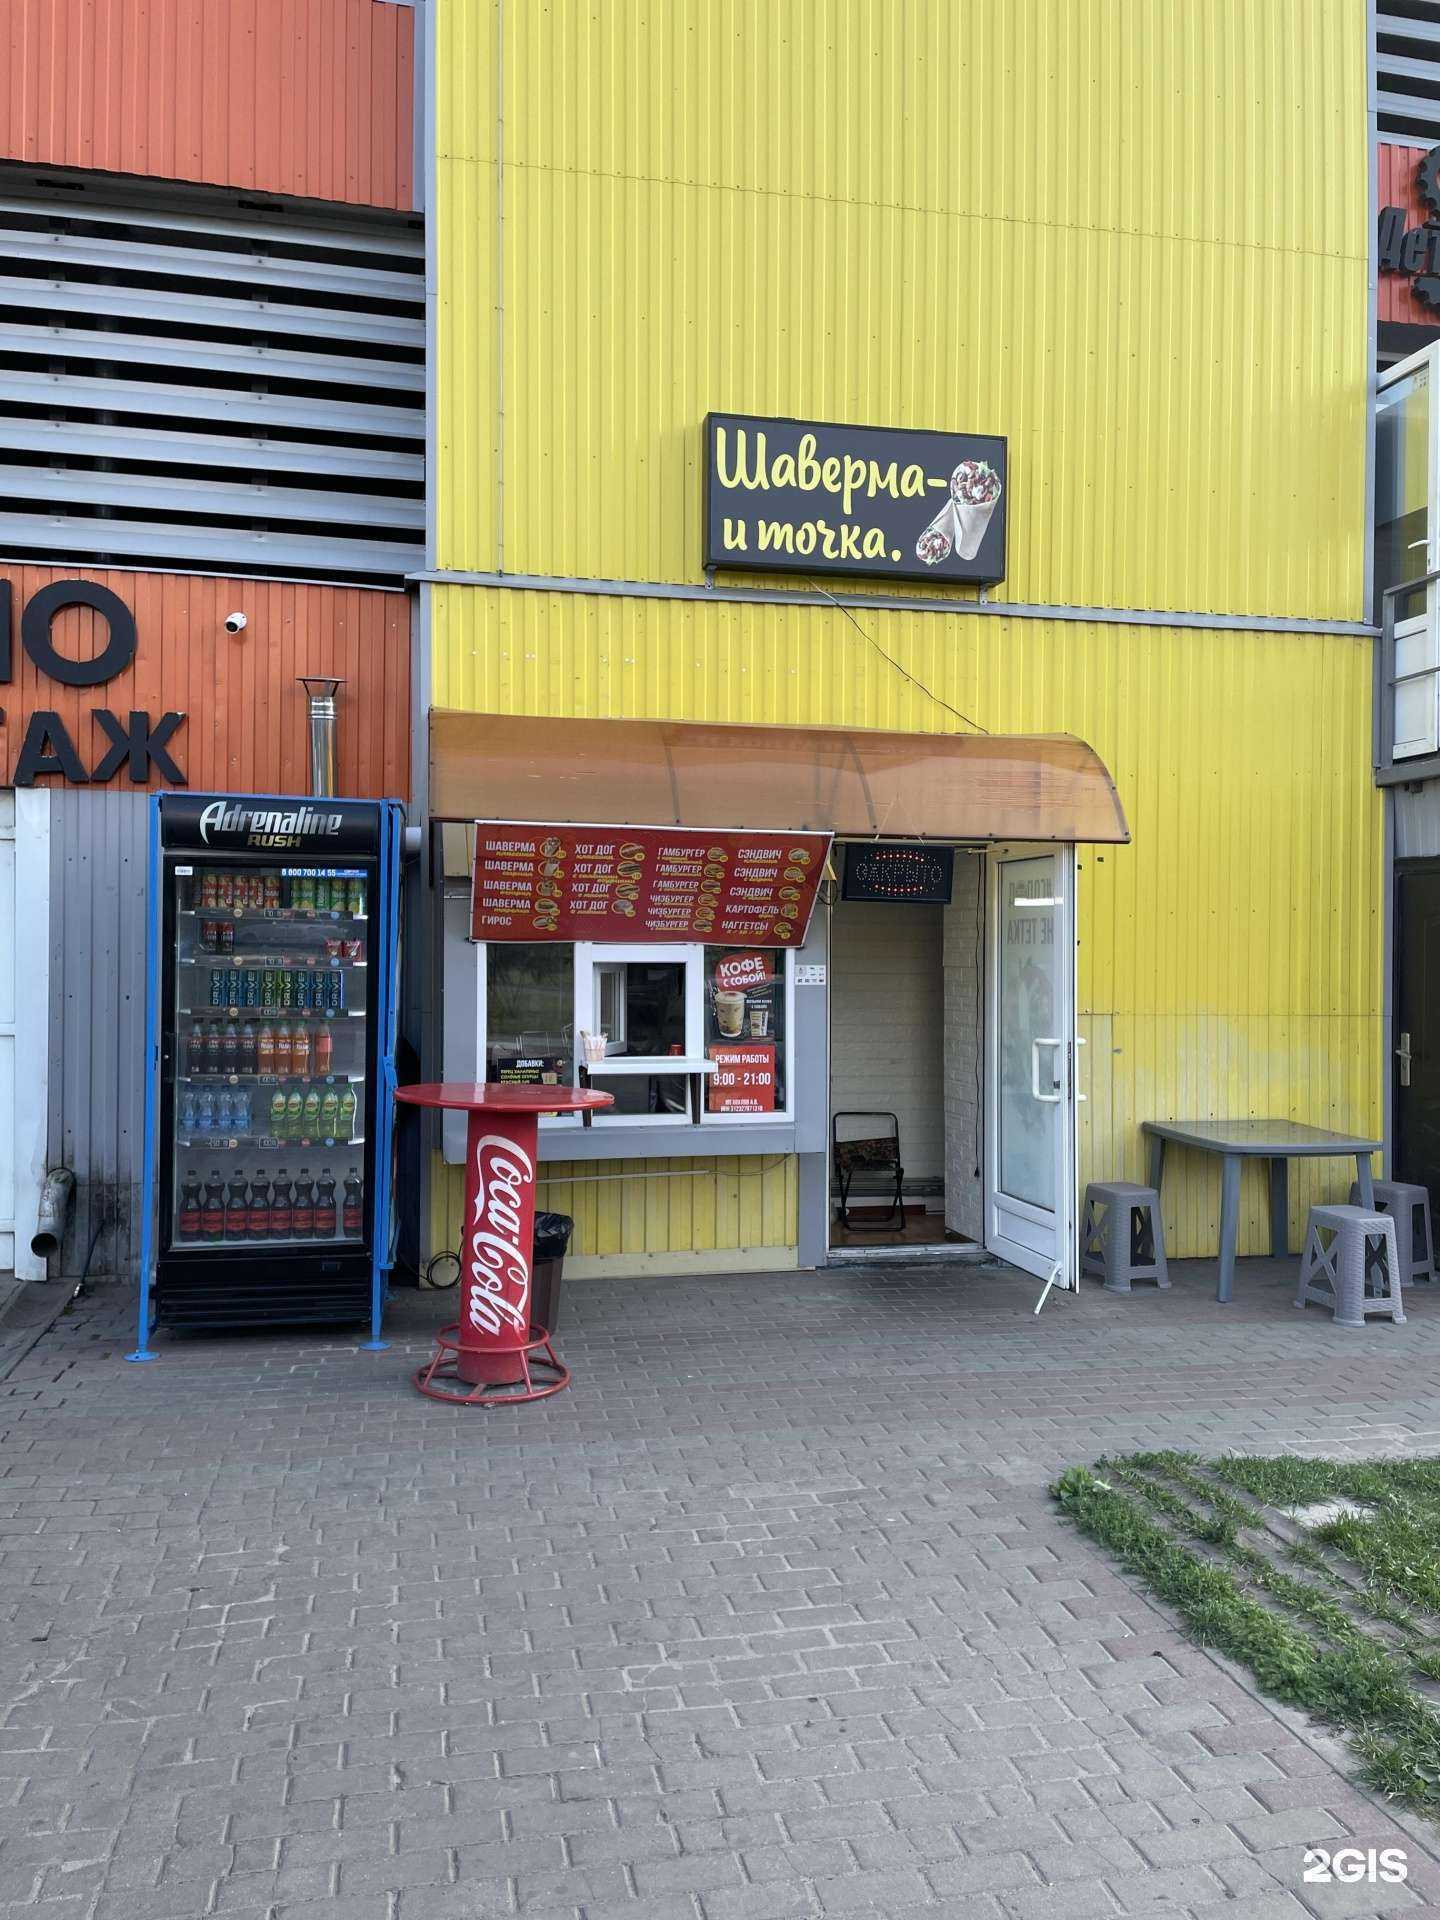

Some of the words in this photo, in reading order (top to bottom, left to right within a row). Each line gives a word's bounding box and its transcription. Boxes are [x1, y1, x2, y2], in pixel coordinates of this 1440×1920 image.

[723, 518, 748, 551] и
[757, 519, 901, 562] точка.
[0, 578, 137, 686] О
[0, 707, 189, 786] АЖ
[200, 800, 342, 844] Adrenaline
[247, 834, 302, 848] RUSH
[485, 841, 536, 852] ШАВЕРМА
[575, 844, 595, 855] ХОТ
[595, 844, 616, 856] ДОГ
[658, 847, 706, 857] ГАМБУРГЕР
[737, 848, 782, 860] СЭНДВИЧ
[484, 861, 534, 872] ШАВЕРМА
[573, 863, 593, 874] ХОТ
[594, 863, 614, 874] ДОГ
[655, 864, 703, 873] ГАМБУРГЕР
[733, 867, 778, 878] СЭНДВИЧ
[483, 880, 532, 891] ШАВЕРМА
[571, 882, 590, 893] ХОТ
[591, 883, 611, 894] ДОГ
[652, 880, 699, 889] ГАМБУРГЕР
[729, 887, 773, 897] СЭНДВИЧ
[482, 898, 531, 909] ШАВЕРМА
[649, 894, 694, 904] ЧИЗБУРГЕР
[569, 900, 588, 911] ХОТ
[589, 901, 609, 912] ДОГ
[647, 907, 692, 916] ЧИЗБУРГЕР
[725, 904, 780, 914] КАРТОФЕЛЬ
[481, 915, 512, 926] ГИРОС
[645, 920, 689, 929] ЧИЗБУРГЕР
[721, 920, 769, 931] НАГГЕТСЫ
[720, 957, 764, 977] КОФЕ
[730, 972, 766, 986] СОБОЙ!
[715, 1054, 741, 1063] РЕЖИМ
[742, 1054, 769, 1064] РАБОТЫ
[713, 1073, 735, 1085] 9:00
[744, 1073, 771, 1085] 21:00
[469, 1135, 533, 1344] Coca-Cola
